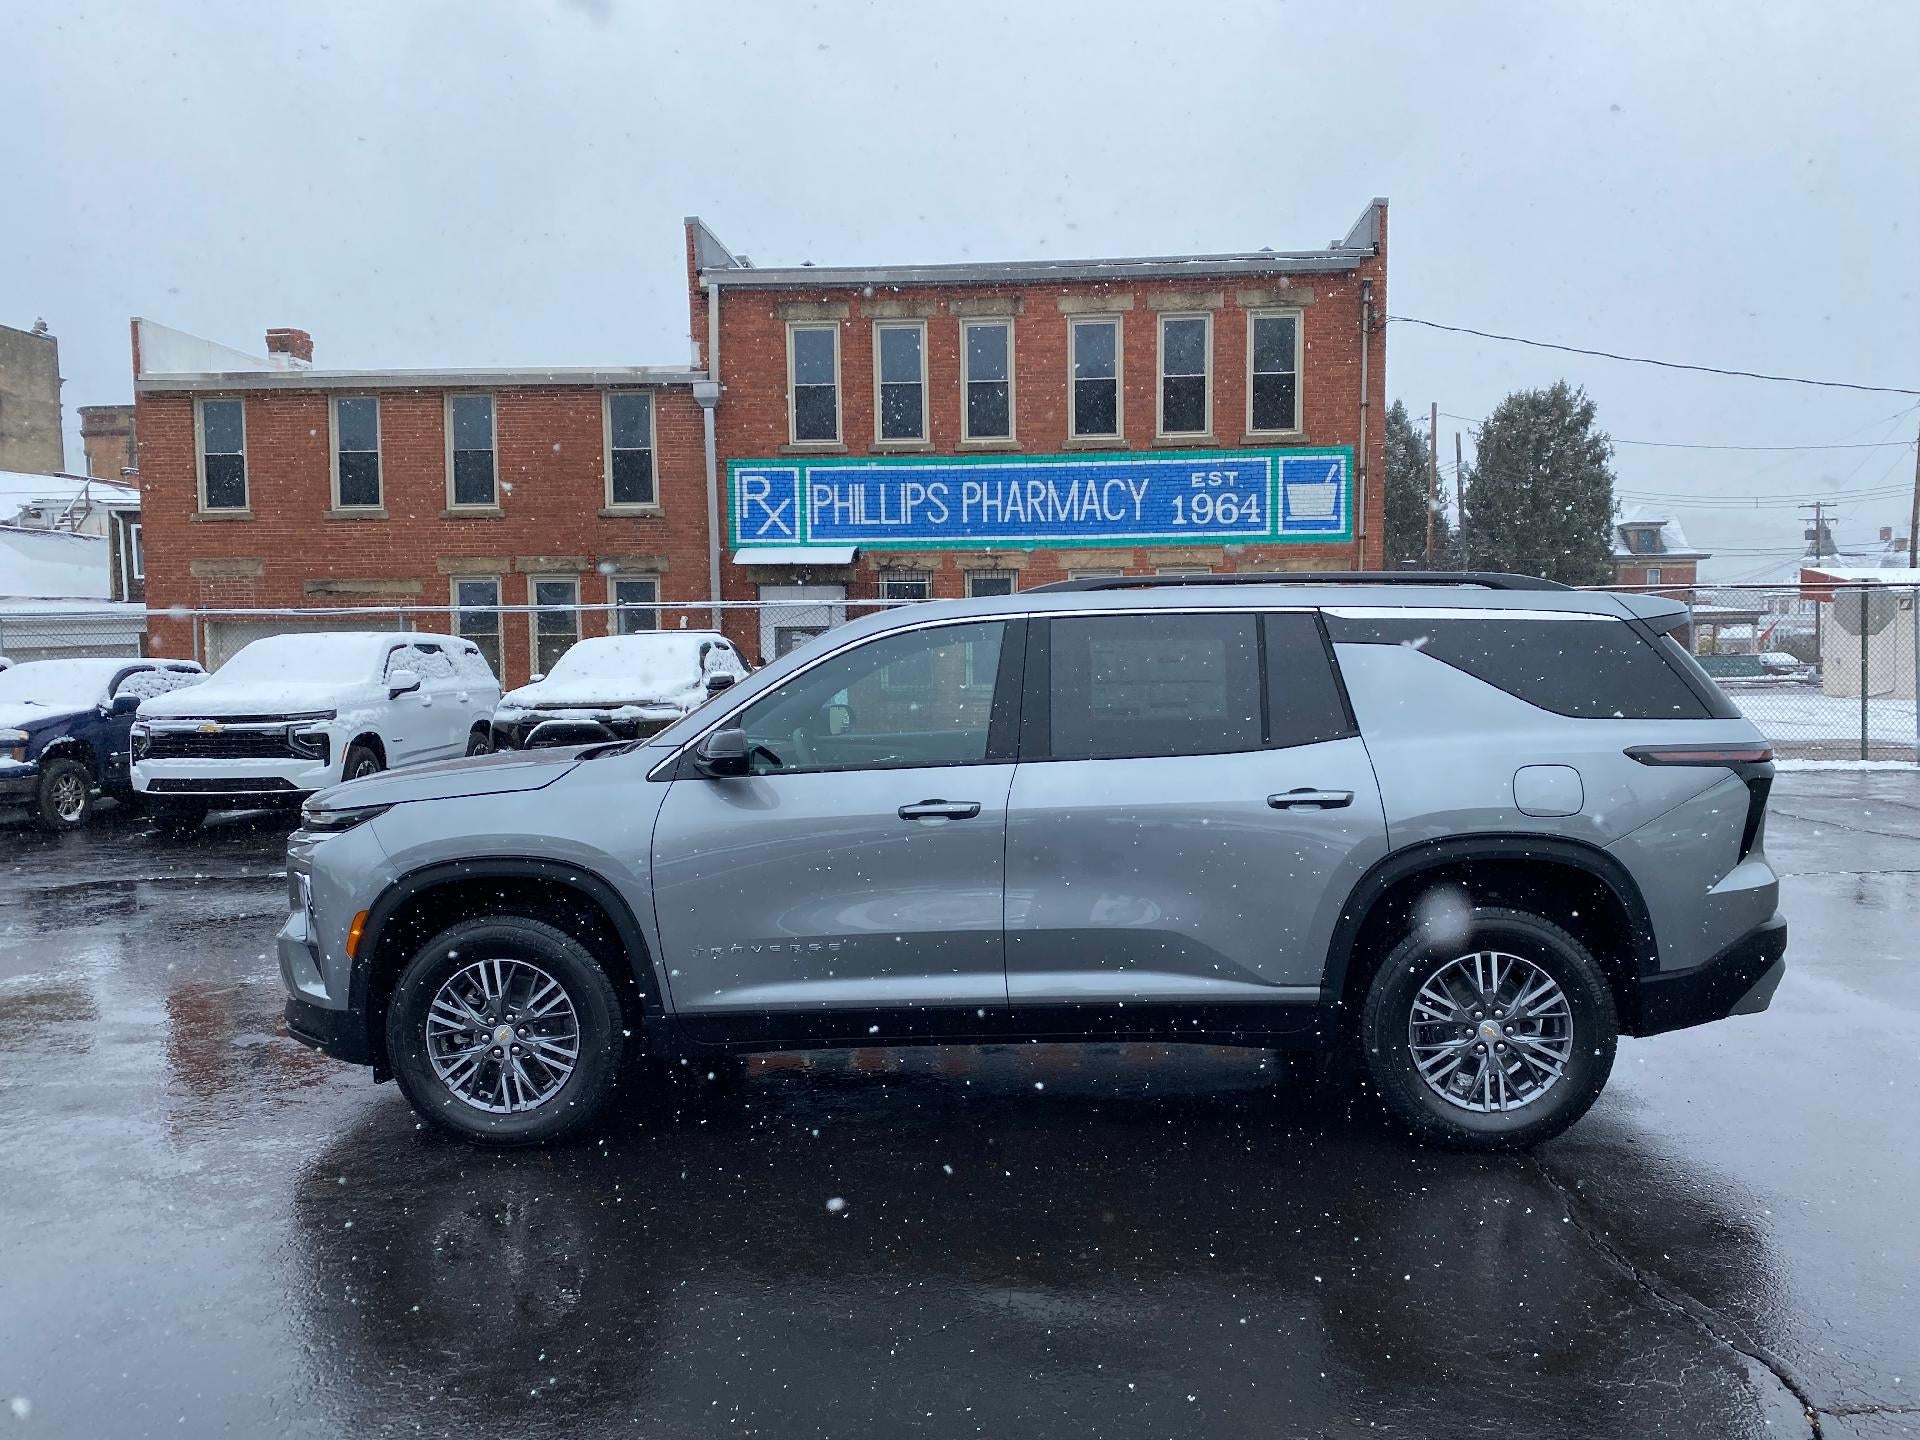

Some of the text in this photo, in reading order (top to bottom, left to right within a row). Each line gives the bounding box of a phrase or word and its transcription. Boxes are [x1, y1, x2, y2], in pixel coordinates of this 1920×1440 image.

[1191, 471, 1239, 487] EST
[813, 478, 1149, 525] PHILLIPS PHARMACY
[1172, 493, 1260, 525] 1964
